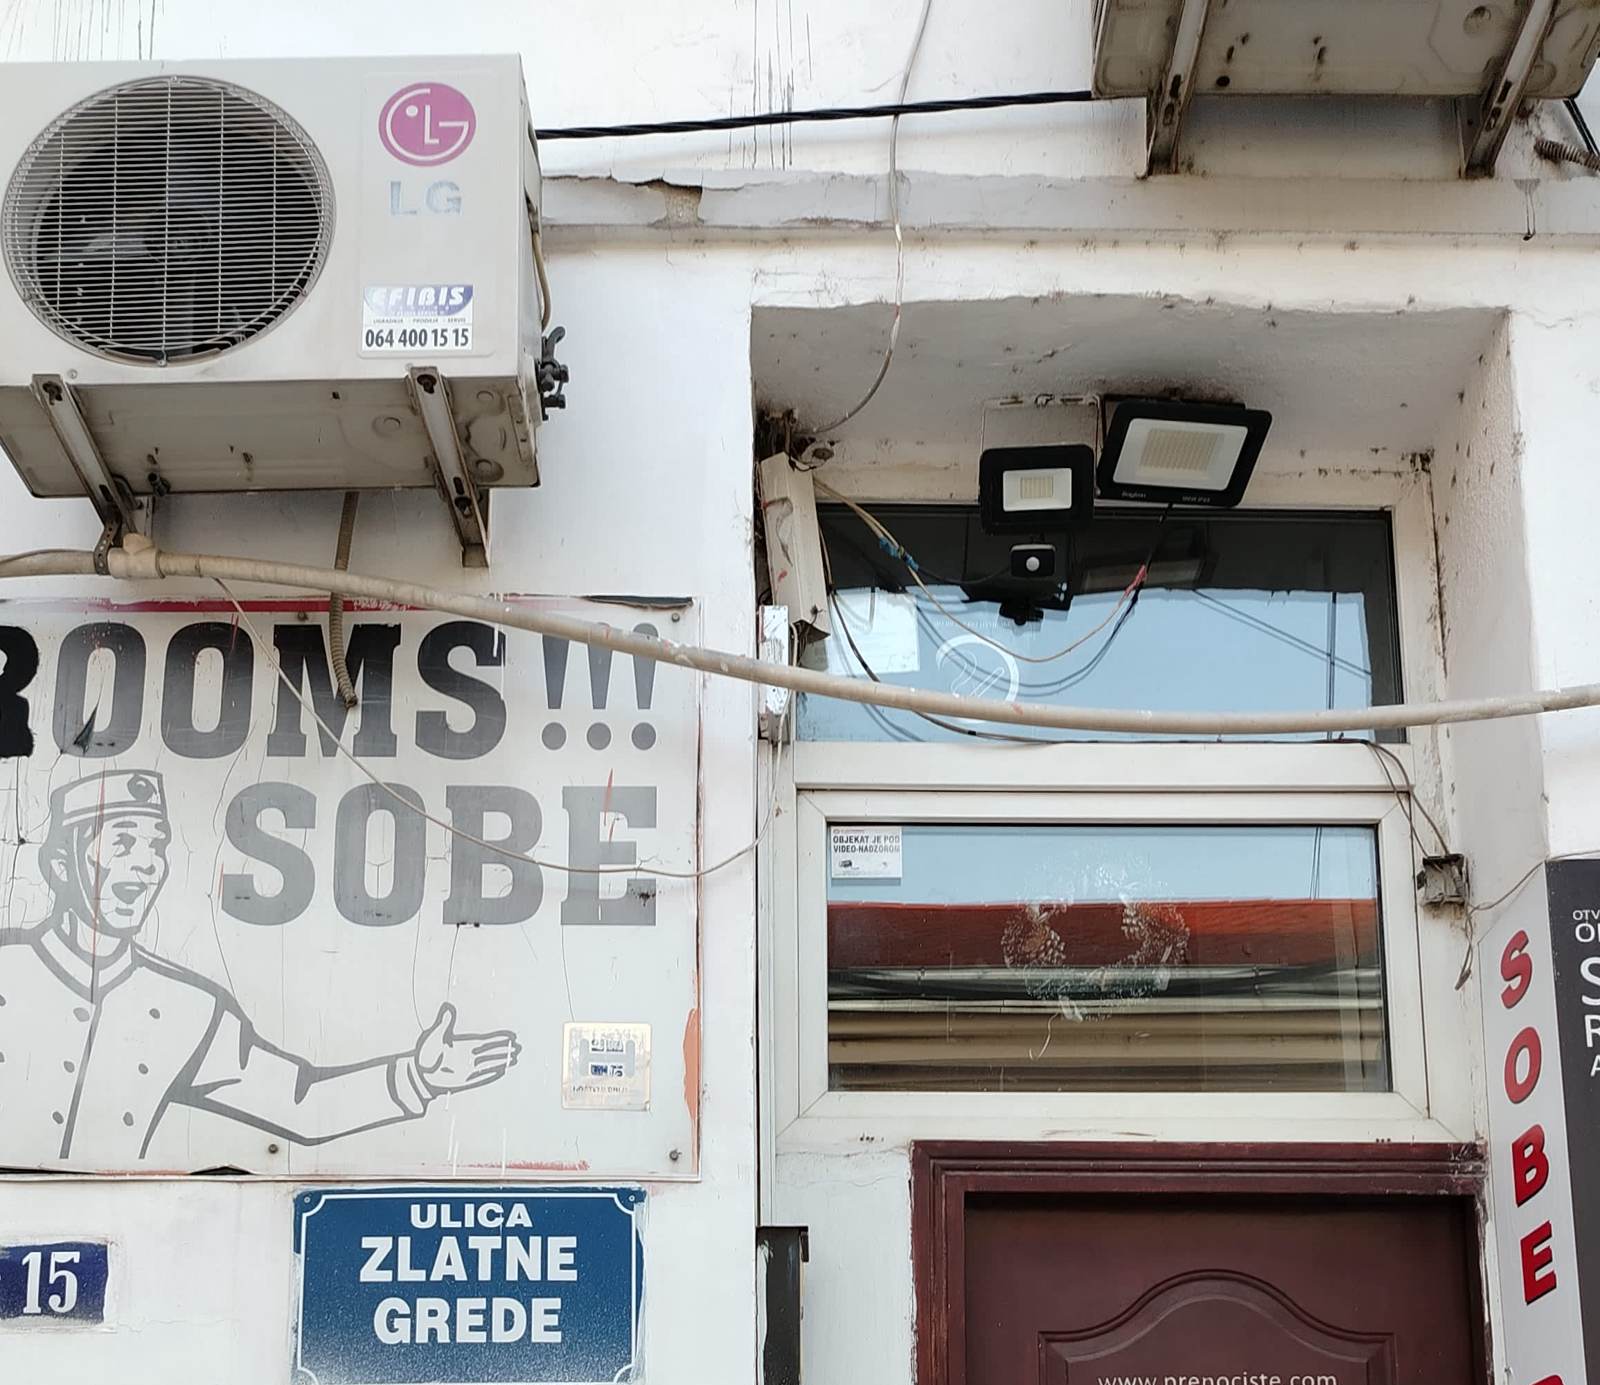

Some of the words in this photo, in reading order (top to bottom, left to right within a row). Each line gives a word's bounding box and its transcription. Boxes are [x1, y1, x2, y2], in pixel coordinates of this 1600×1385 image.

[390, 180, 462, 216] LG
[365, 329, 395, 348] 064
[398, 328, 428, 347] 400
[431, 328, 448, 347] 15
[452, 328, 469, 347] 15
[221, 781, 657, 927] SOBE
[833, 835, 869, 844] OBJEKAT
[872, 835, 882, 844] JE
[884, 835, 900, 844] POD
[410, 1202, 533, 1229] ULICA
[359, 1236, 578, 1282] ZLATNE
[22, 1251, 80, 1314] 15
[373, 1297, 562, 1345] GREDE
